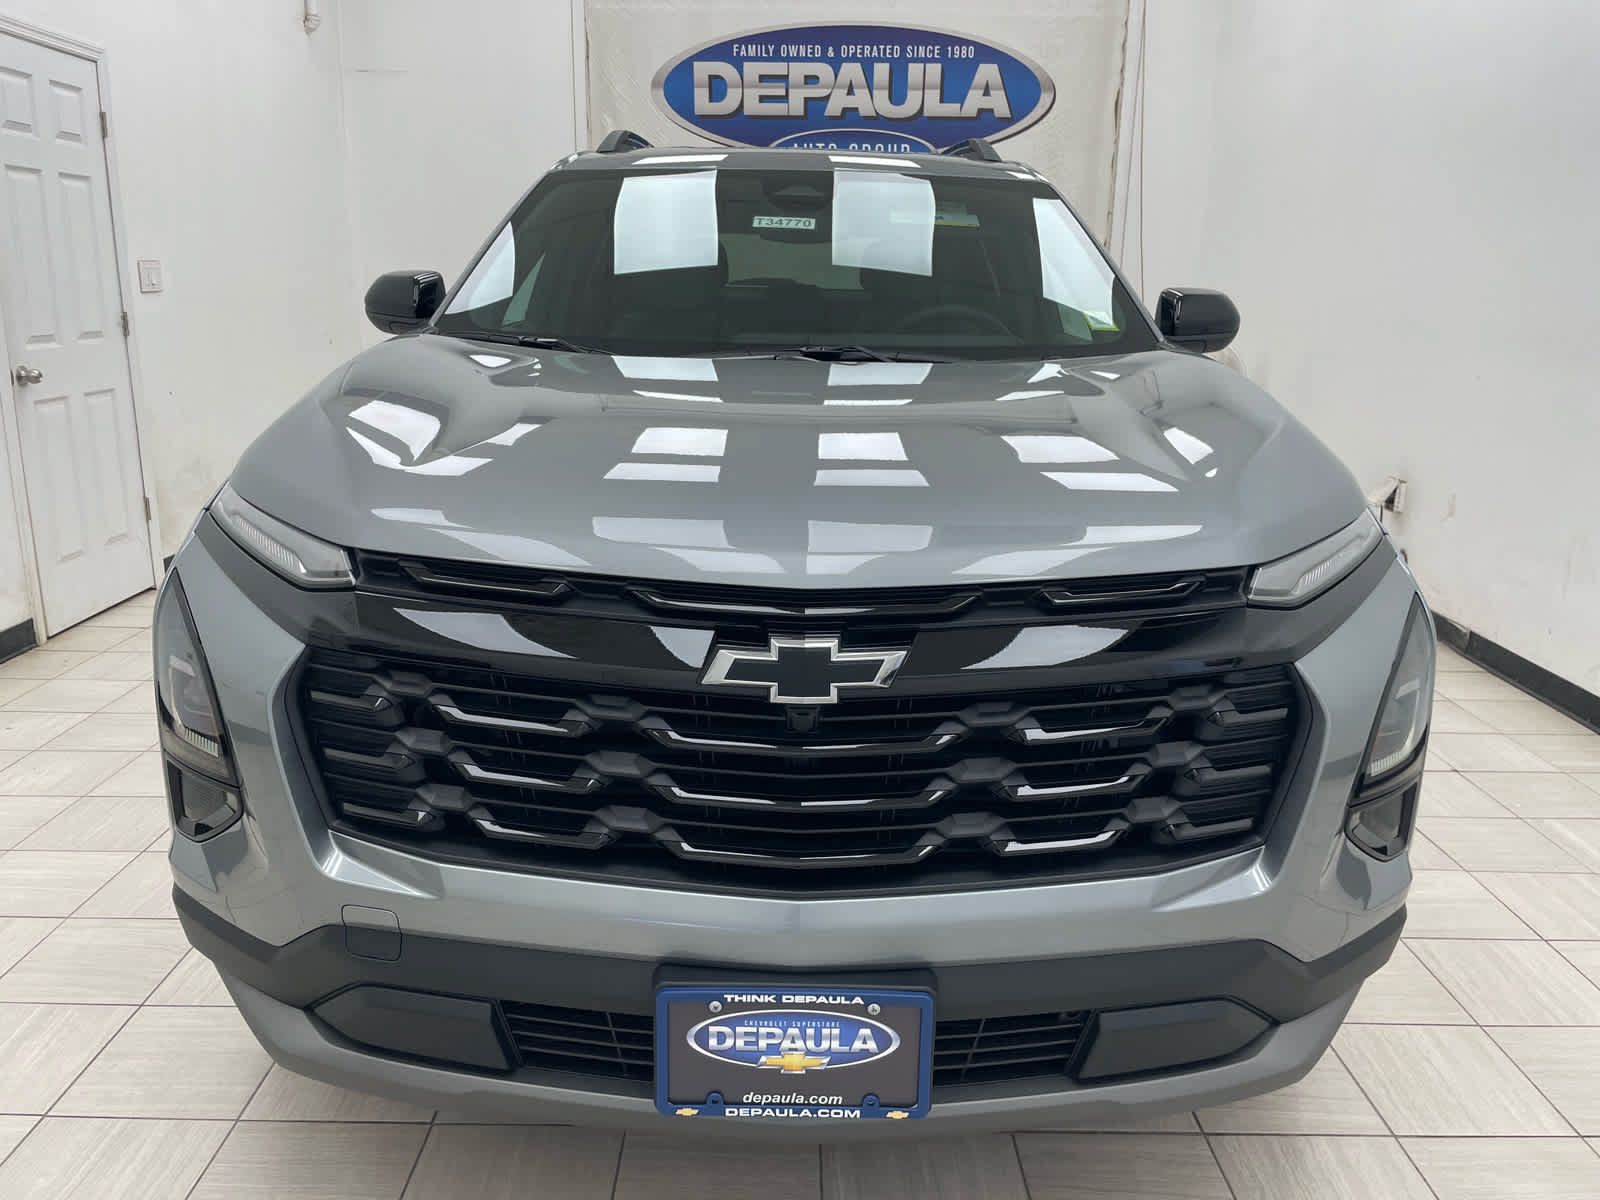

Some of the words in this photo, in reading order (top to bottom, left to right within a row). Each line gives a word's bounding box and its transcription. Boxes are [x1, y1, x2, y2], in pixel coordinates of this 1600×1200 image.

[733, 44, 774, 57] FAMILY
[781, 44, 821, 58] OWNED
[827, 47, 835, 58] &
[841, 45, 900, 58] OPERATED
[906, 45, 940, 58] SINCE
[947, 45, 975, 58] 1980
[693, 61, 1012, 119] DEPAULA
[756, 217, 812, 228] T34770
[724, 994, 776, 1003] THINK
[782, 994, 865, 1005] DEPAULA
[708, 1025, 879, 1054] DEPAULA
[743, 1092, 843, 1106] depaula.com
[725, 1107, 861, 1119] DEPAULA.COM
